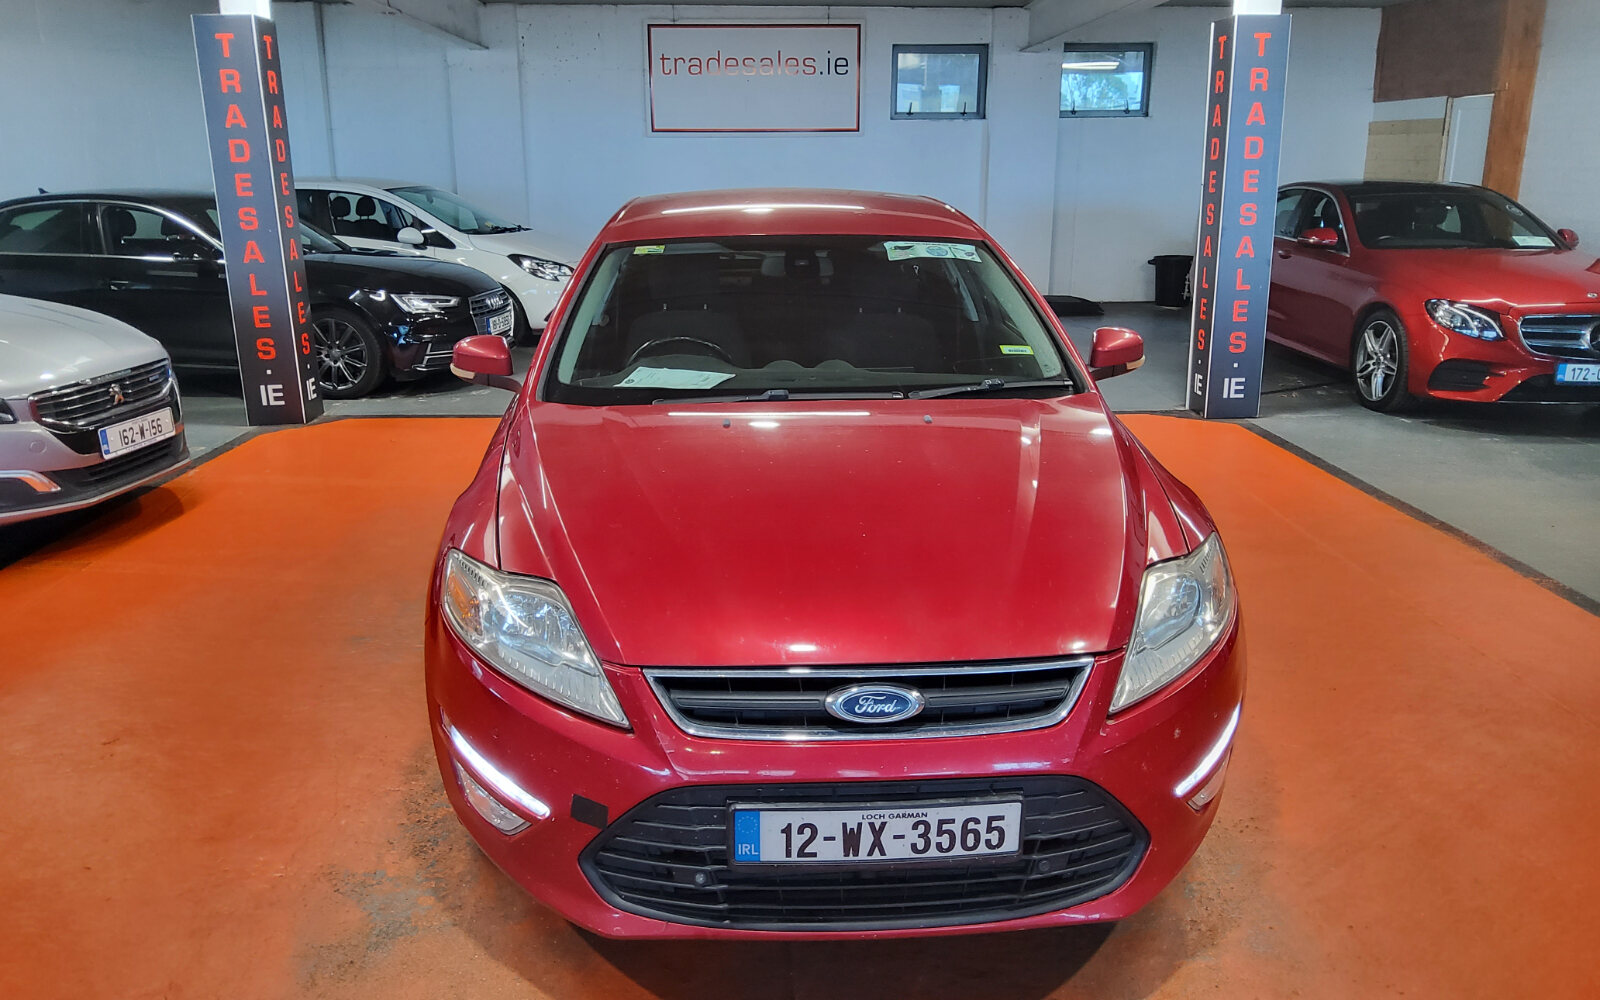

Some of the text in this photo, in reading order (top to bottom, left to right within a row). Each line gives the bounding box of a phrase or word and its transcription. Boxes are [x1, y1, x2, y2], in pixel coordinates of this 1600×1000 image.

[660, 50, 849, 76] tradesales.ie
[214, 33, 286, 406] TRADESALES.IE
[263, 35, 318, 401] TRADESALES.IE
[1194, 36, 1228, 396] TRADESALES.IE
[1222, 33, 1272, 399] TRADESALES.IE
[118, 417, 163, 447] 162-W-156
[854, 695, 898, 714] Ford
[861, 811, 928, 821] LOCH GARMAN
[738, 844, 759, 855] IRL
[780, 814, 1006, 859] 12-WX-3565
